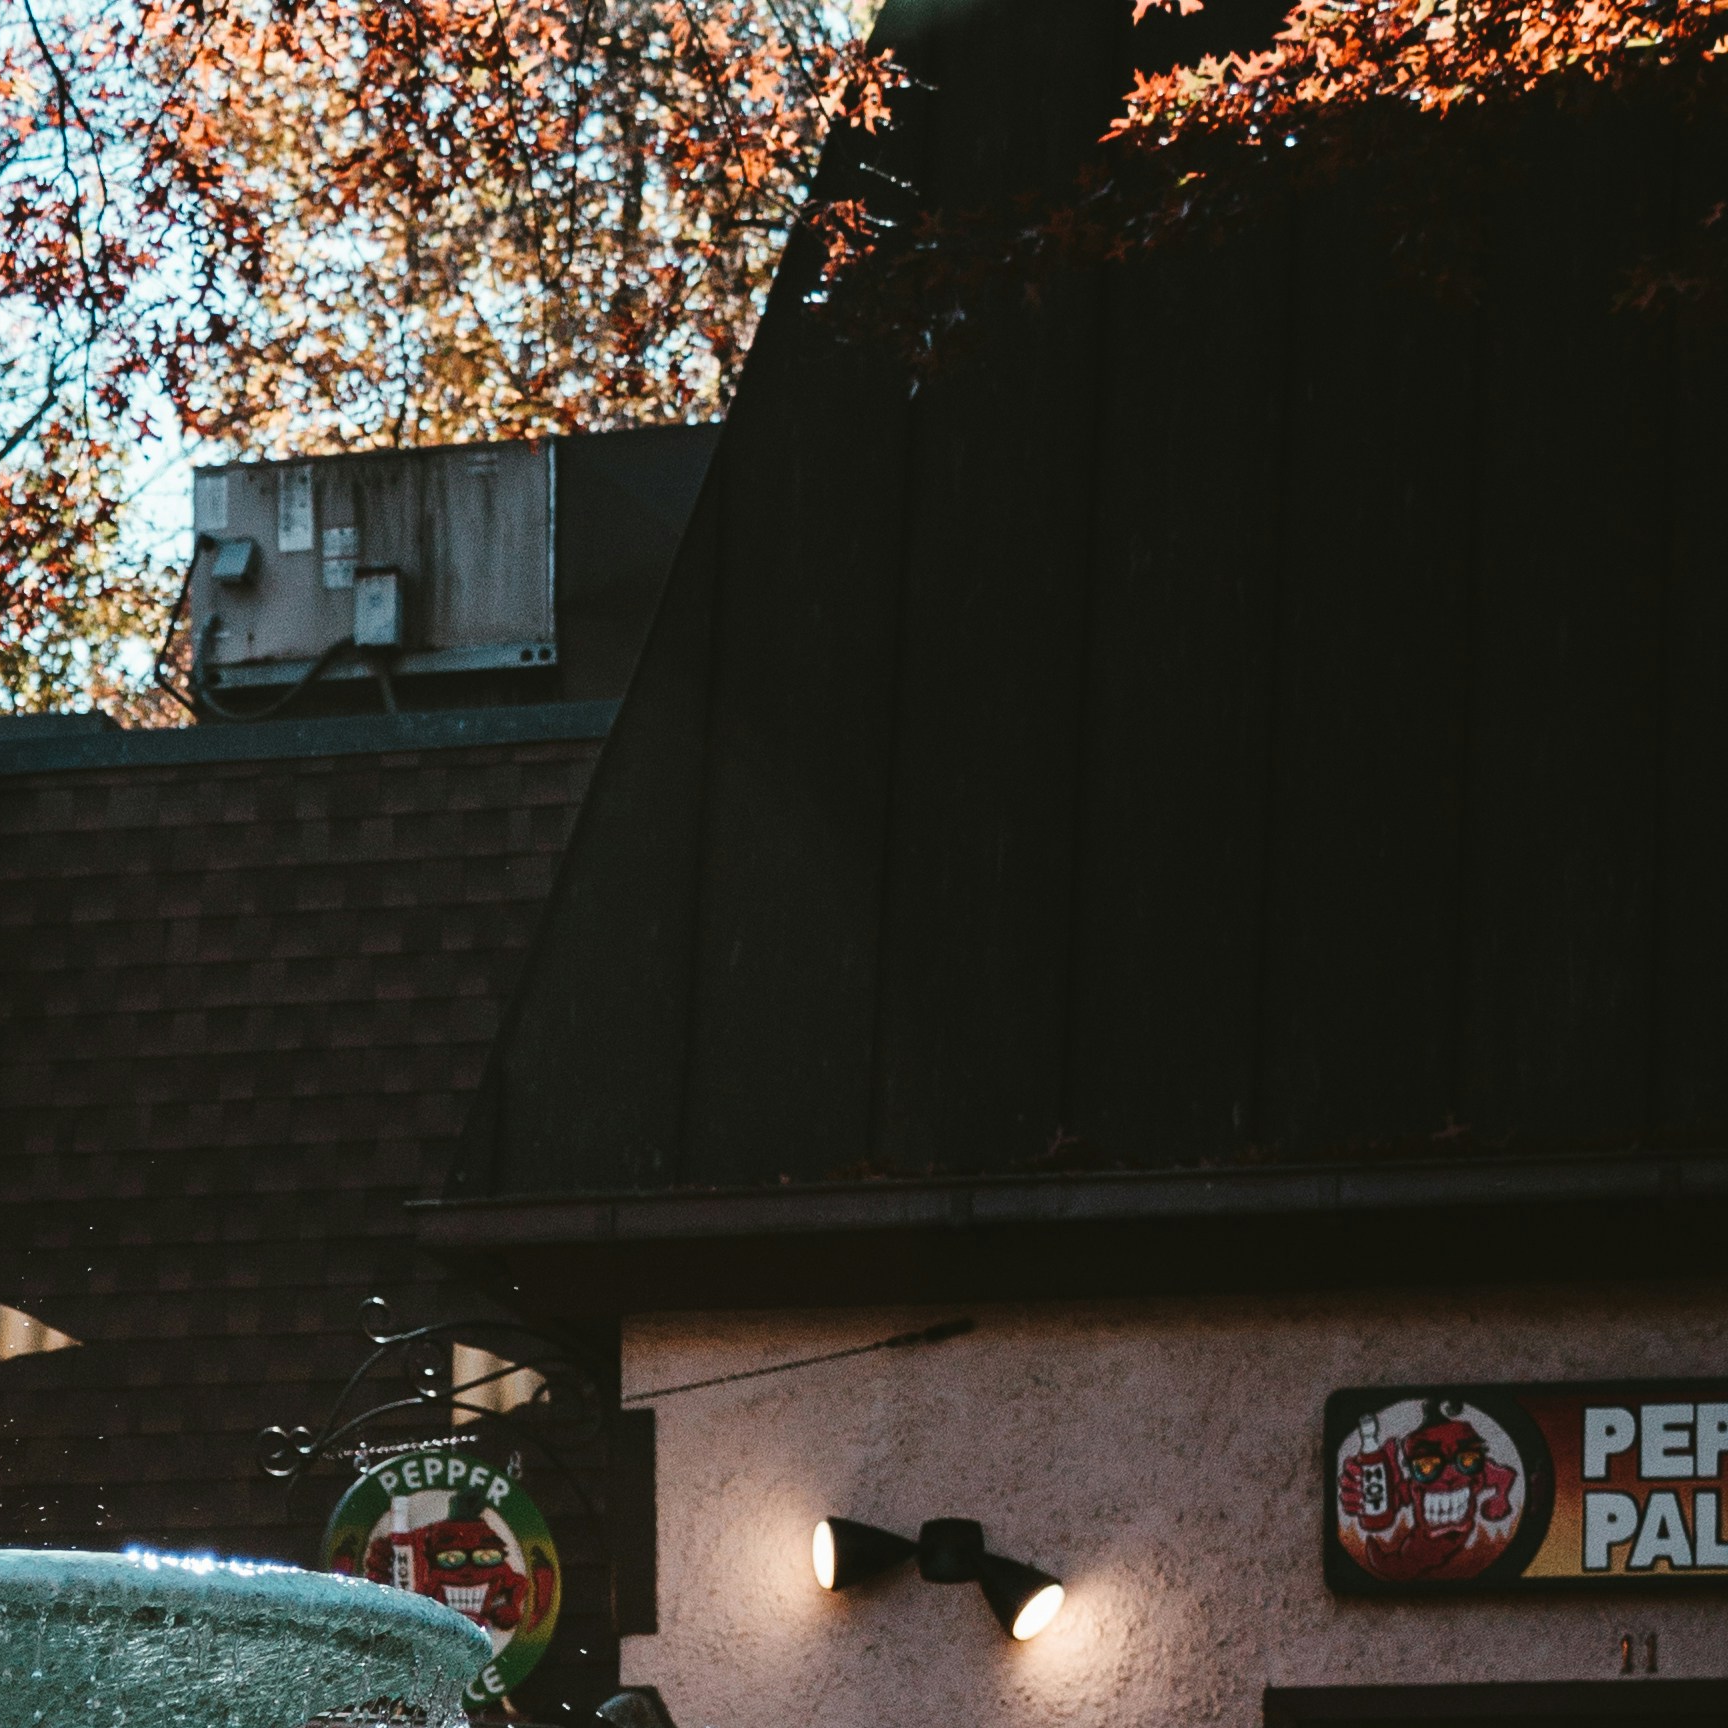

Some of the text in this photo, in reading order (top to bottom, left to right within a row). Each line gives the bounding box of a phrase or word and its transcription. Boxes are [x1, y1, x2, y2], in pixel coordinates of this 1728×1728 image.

[1583, 1403, 1728, 1479] PEP
[377, 1457, 510, 1507] PEPPER
[1363, 1466, 1384, 1511] HOT
[1583, 1490, 1728, 1569] PAL
